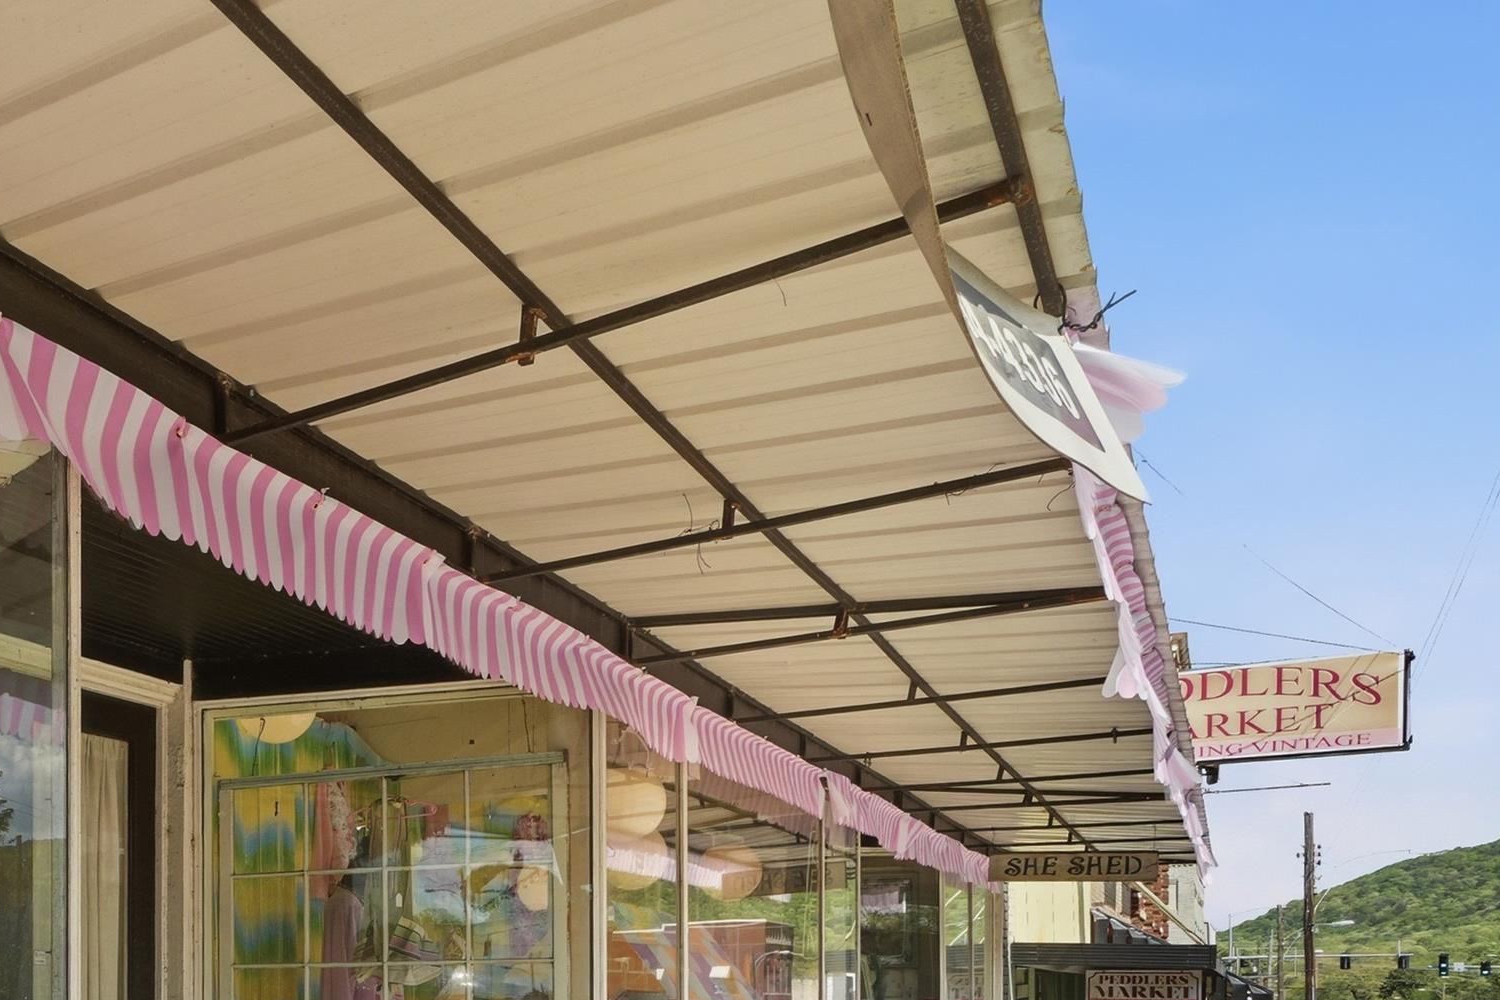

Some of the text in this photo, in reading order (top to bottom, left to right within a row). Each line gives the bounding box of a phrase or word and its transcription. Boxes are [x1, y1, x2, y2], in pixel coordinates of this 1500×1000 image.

[1251, 733, 1372, 753] VINTAGE
[1004, 855, 1142, 876] SHE SHED
[1099, 975, 1189, 985] PEDDLERS
[1095, 985, 1194, 999] MARKET
